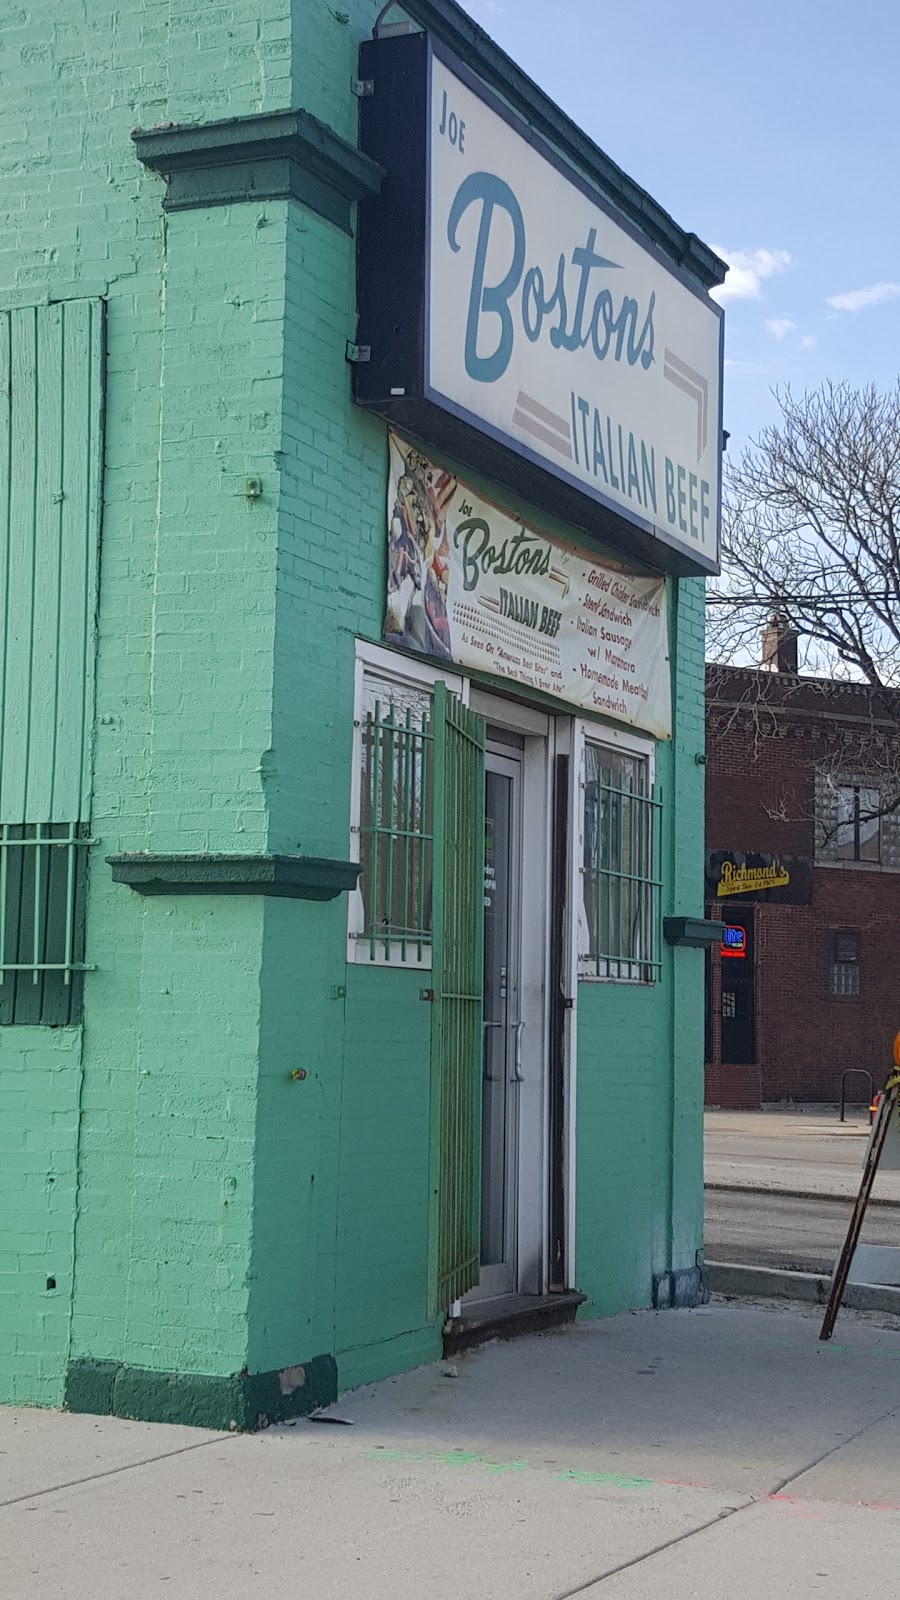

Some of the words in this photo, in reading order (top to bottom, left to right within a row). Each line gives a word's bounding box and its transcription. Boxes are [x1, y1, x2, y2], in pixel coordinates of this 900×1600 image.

[439, 90, 465, 154] JOE
[447, 171, 656, 383] Bostons
[570, 391, 658, 514] ITALIAN
[665, 456, 710, 543] BEEF
[458, 499, 473, 517] JOE
[453, 517, 552, 591] Bostons
[499, 587, 539, 629] ITALIAN
[538, 605, 563, 638] BEEF
[587, 569, 613, 592] Grilled
[629, 594, 660, 618] Sandich
[576, 615, 598, 638] Italian
[600, 626, 632, 651] Sausage
[598, 603, 632, 627] Sandwich
[461, 632, 469, 644] As
[470, 636, 484, 650] Seen
[485, 642, 495, 654] On
[522, 657, 533, 671] Best
[550, 670, 563, 680] and
[587, 646, 601, 660] w/
[519, 670, 534, 686] Thing
[539, 678, 551, 690] Ever
[580, 662, 619, 691] Homemade
[622, 678, 649, 702] Meatbal
[592, 691, 628, 714] Sandwich
[721, 860, 788, 886] Richmond's
